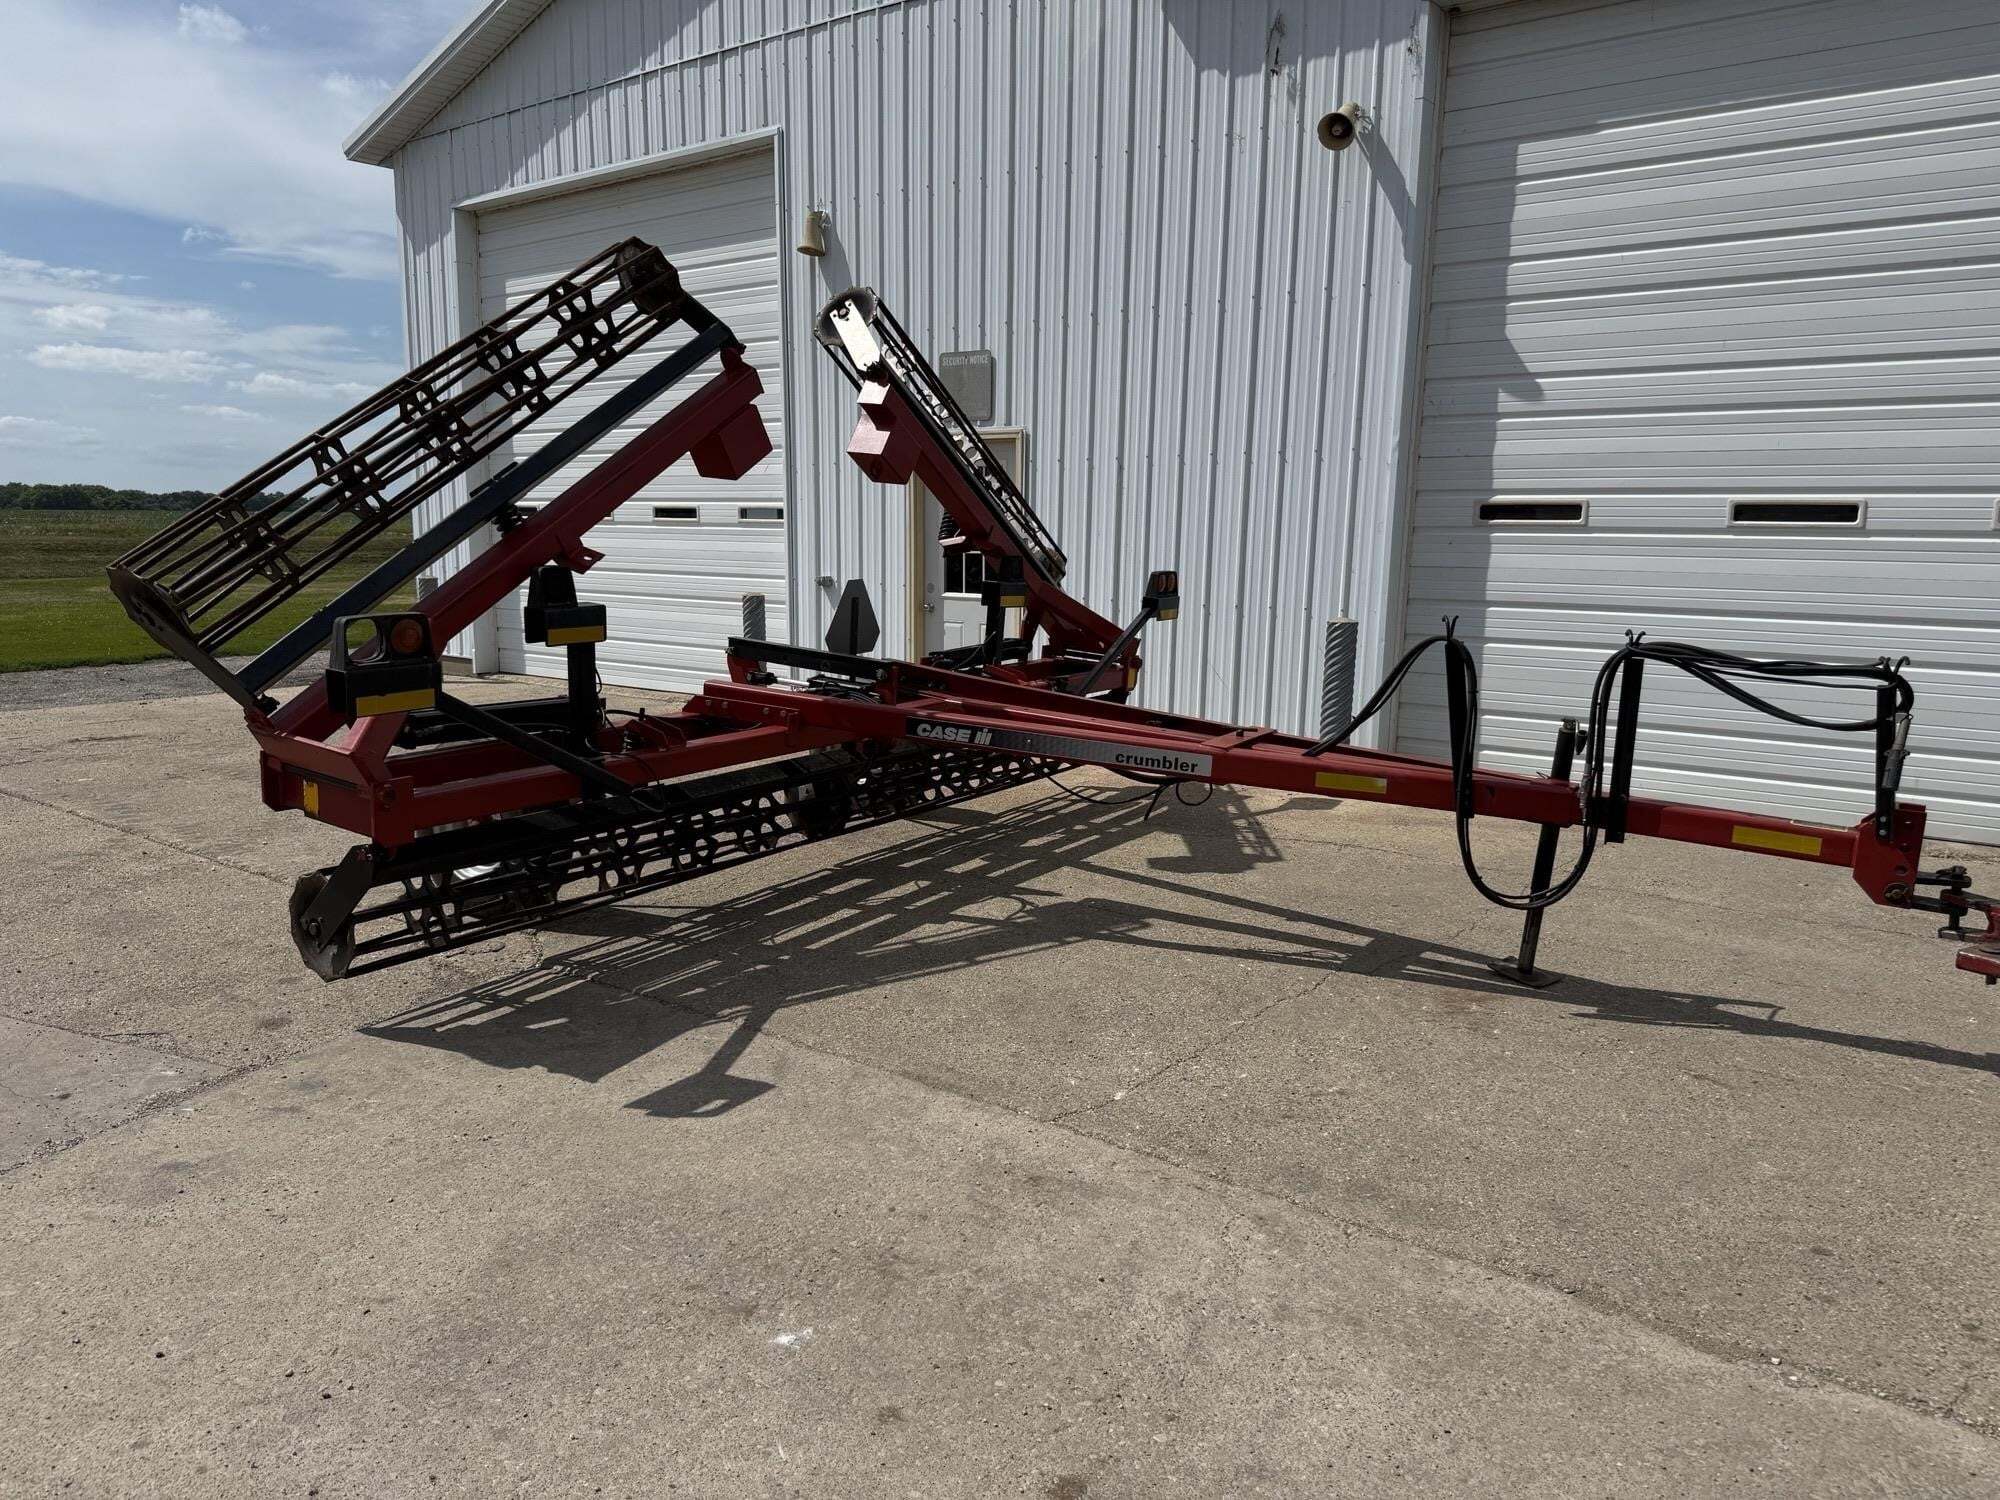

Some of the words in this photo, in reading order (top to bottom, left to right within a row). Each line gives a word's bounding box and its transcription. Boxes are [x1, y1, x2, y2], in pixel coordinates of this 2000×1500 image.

[942, 356, 968, 367] SECURITY
[969, 354, 988, 365] NOTICE
[916, 723, 971, 742] CASE
[1115, 753, 1198, 773] crumbler
